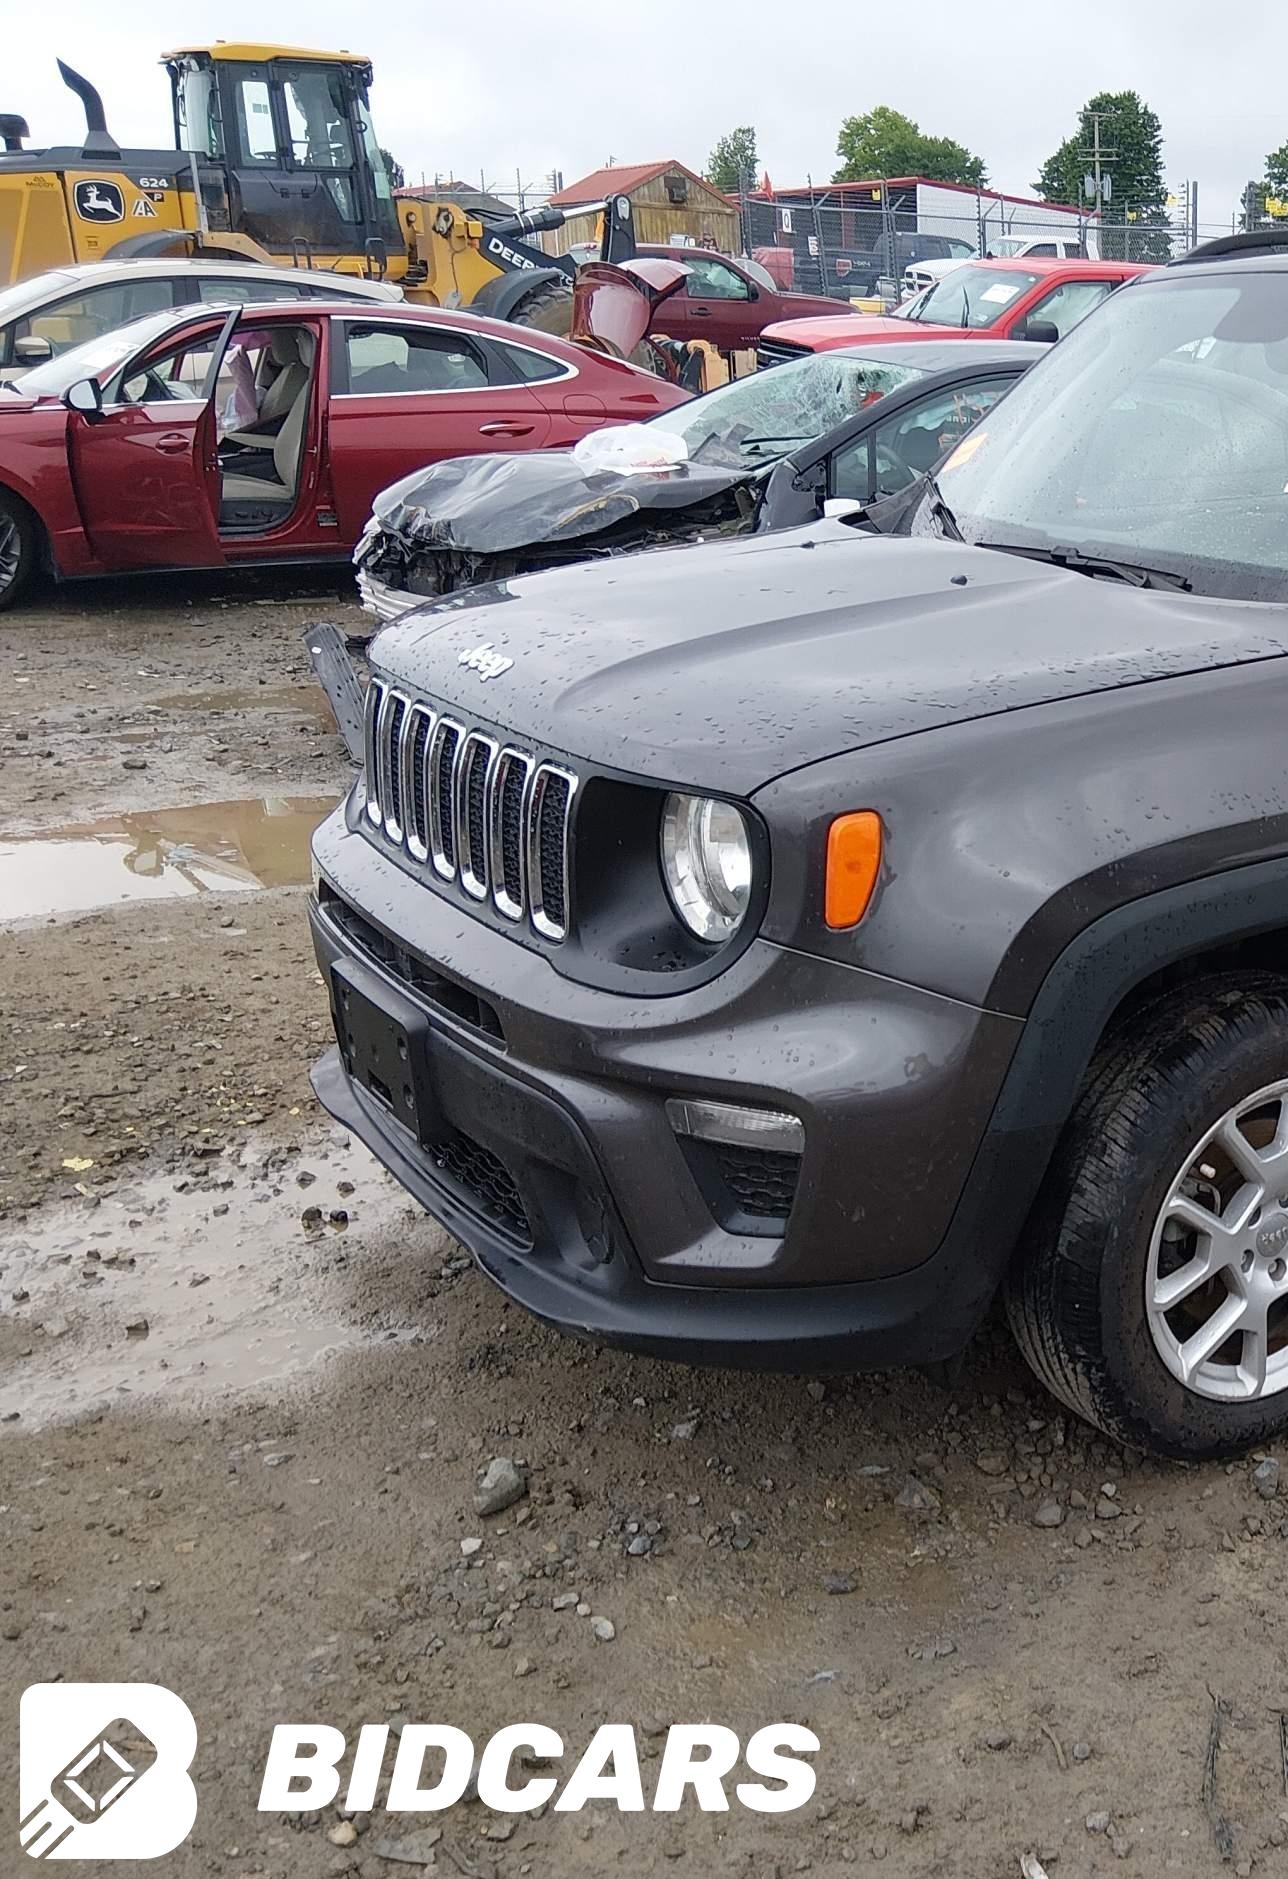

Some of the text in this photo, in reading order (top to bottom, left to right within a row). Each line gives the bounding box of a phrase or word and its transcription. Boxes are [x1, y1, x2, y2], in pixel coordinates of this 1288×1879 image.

[139, 177, 169, 188] 624
[488, 237, 541, 270] DEER
[457, 641, 515, 683] Jeep
